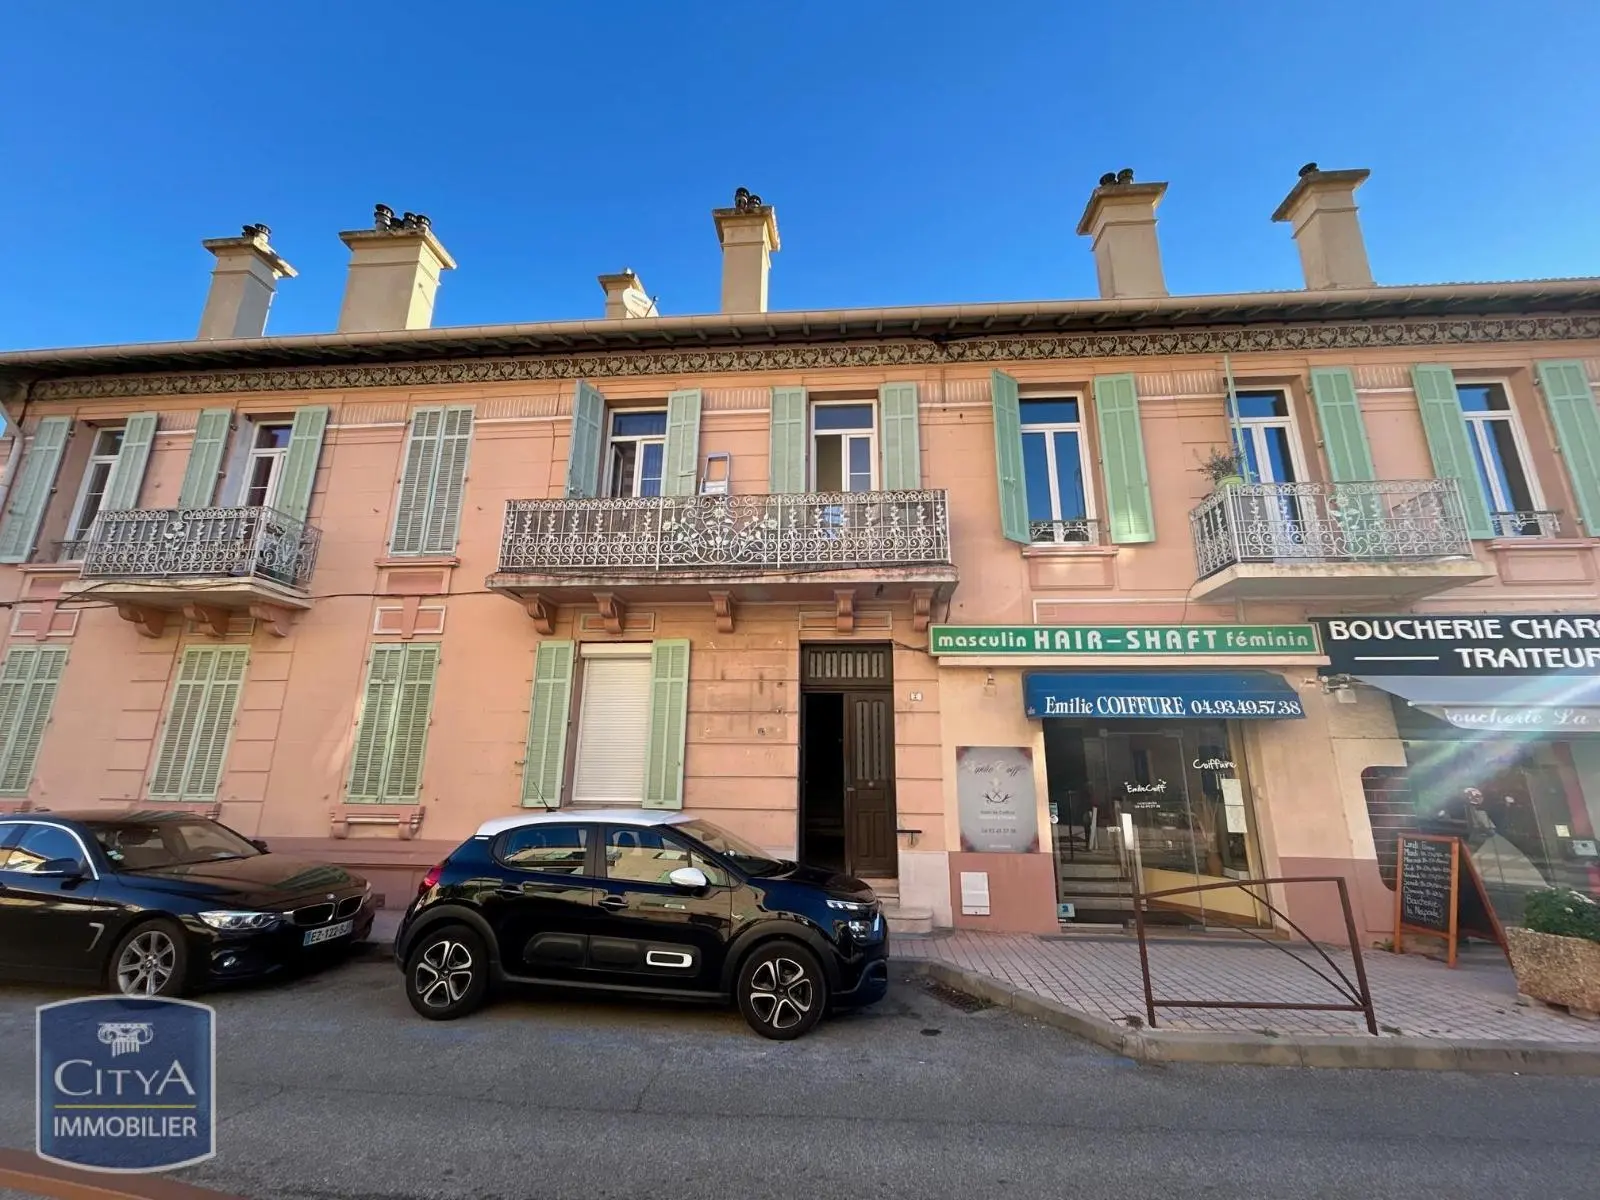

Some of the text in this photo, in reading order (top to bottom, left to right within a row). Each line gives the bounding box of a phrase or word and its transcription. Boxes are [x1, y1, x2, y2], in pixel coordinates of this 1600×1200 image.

[938, 631, 1027, 648] masculin
[1226, 630, 1308, 647] féminin
[1328, 618, 1600, 641] BOUCHERIE CHAR
[1045, 695, 1302, 715] Emilie COIFFURE 04.93.49.57.38
[1192, 758, 1237, 770] Coiffure
